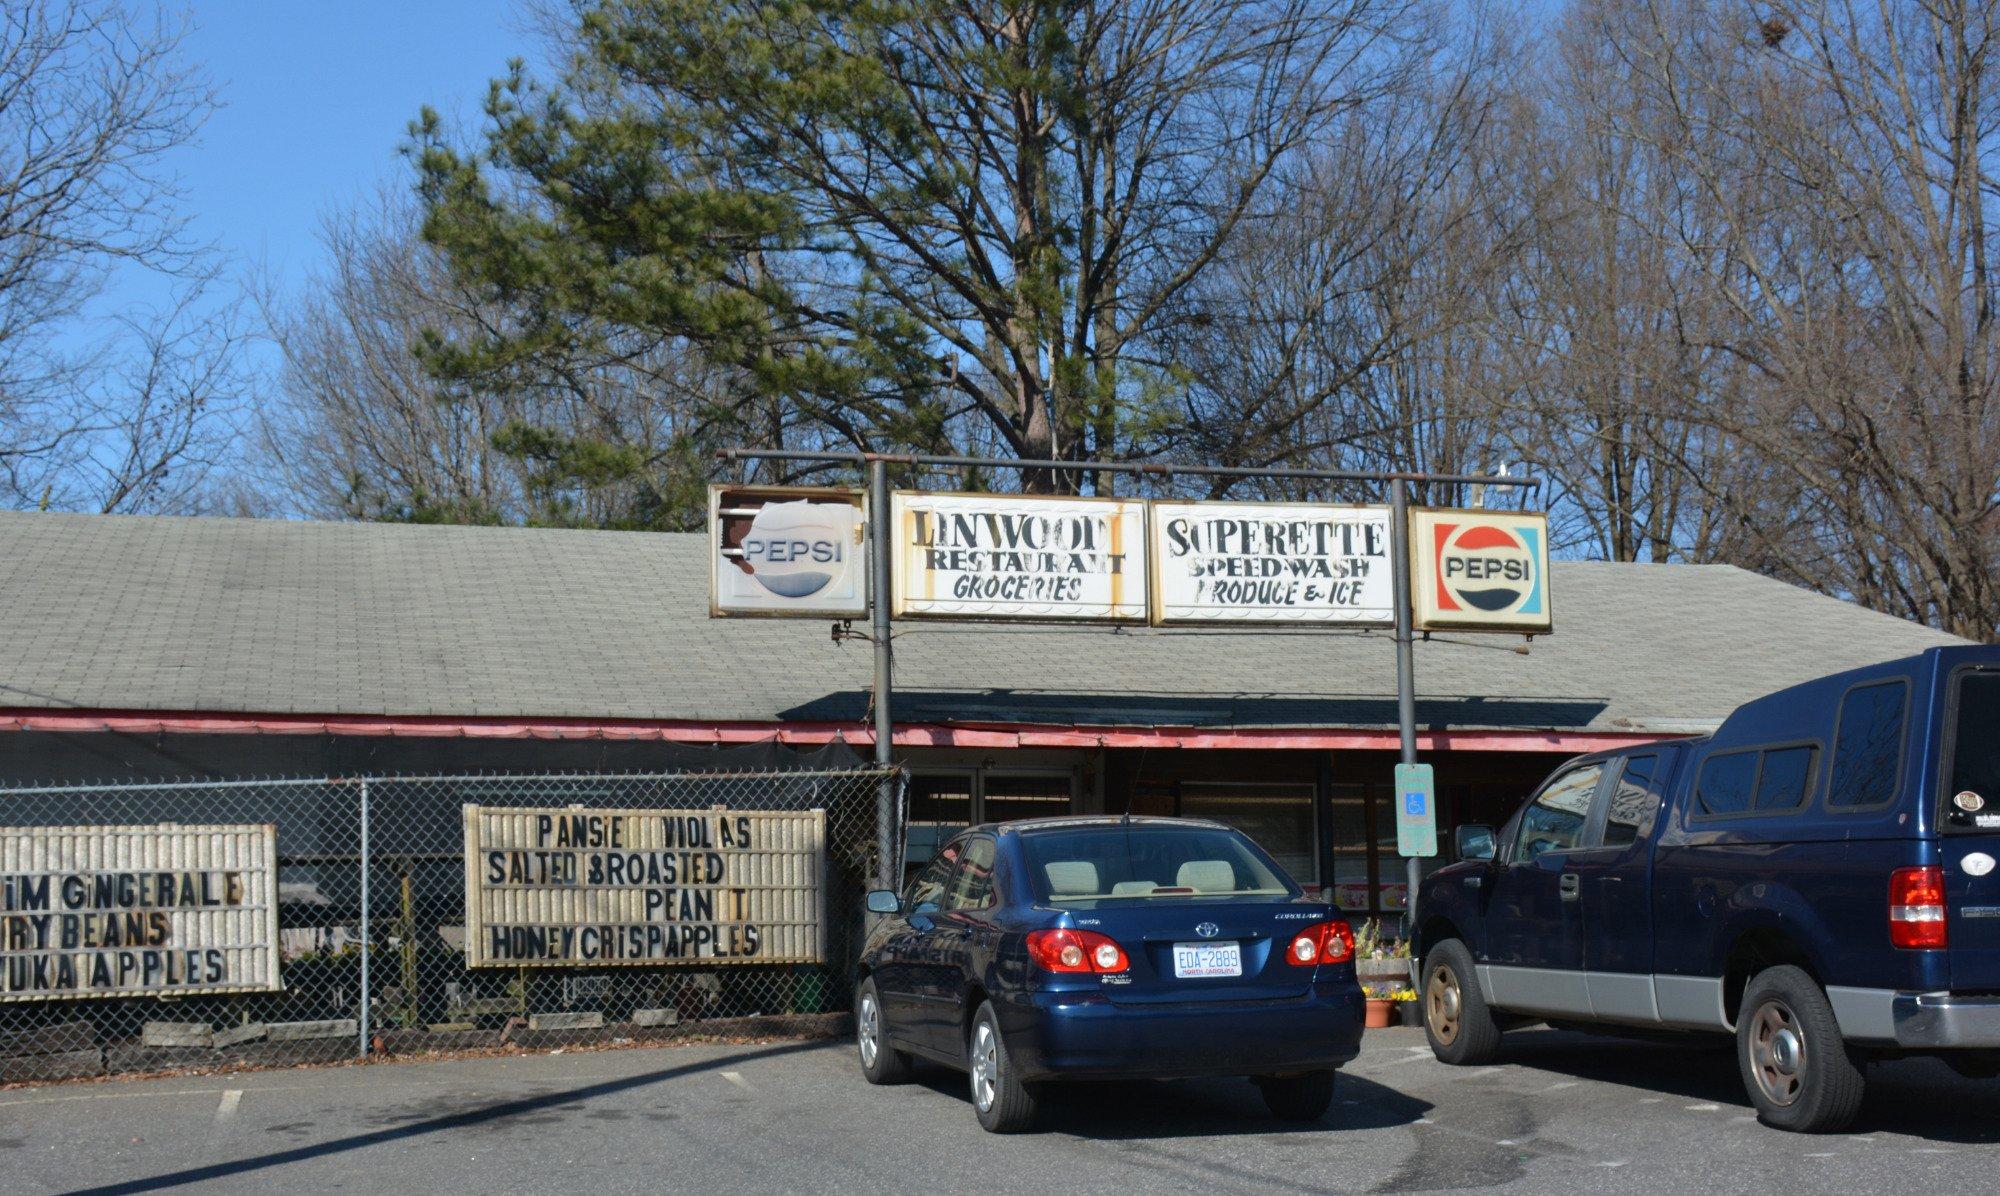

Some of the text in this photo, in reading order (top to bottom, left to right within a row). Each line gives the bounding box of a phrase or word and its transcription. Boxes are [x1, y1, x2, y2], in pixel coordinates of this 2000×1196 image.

[912, 510, 1107, 550] LINWOOD
[1166, 518, 1386, 557] SUPERETTE
[745, 541, 842, 562] PEPSI
[1446, 556, 1530, 581] PEPSI
[953, 574, 1082, 601] GROCERIES
[1303, 585, 1325, 602] &
[1329, 581, 1366, 605] ICE
[488, 851, 577, 885] SALTED
[61, 911, 167, 950] BEANS
[0, 949, 223, 992] UKA APPLES
[1179, 950, 1238, 968] EDA-2889
